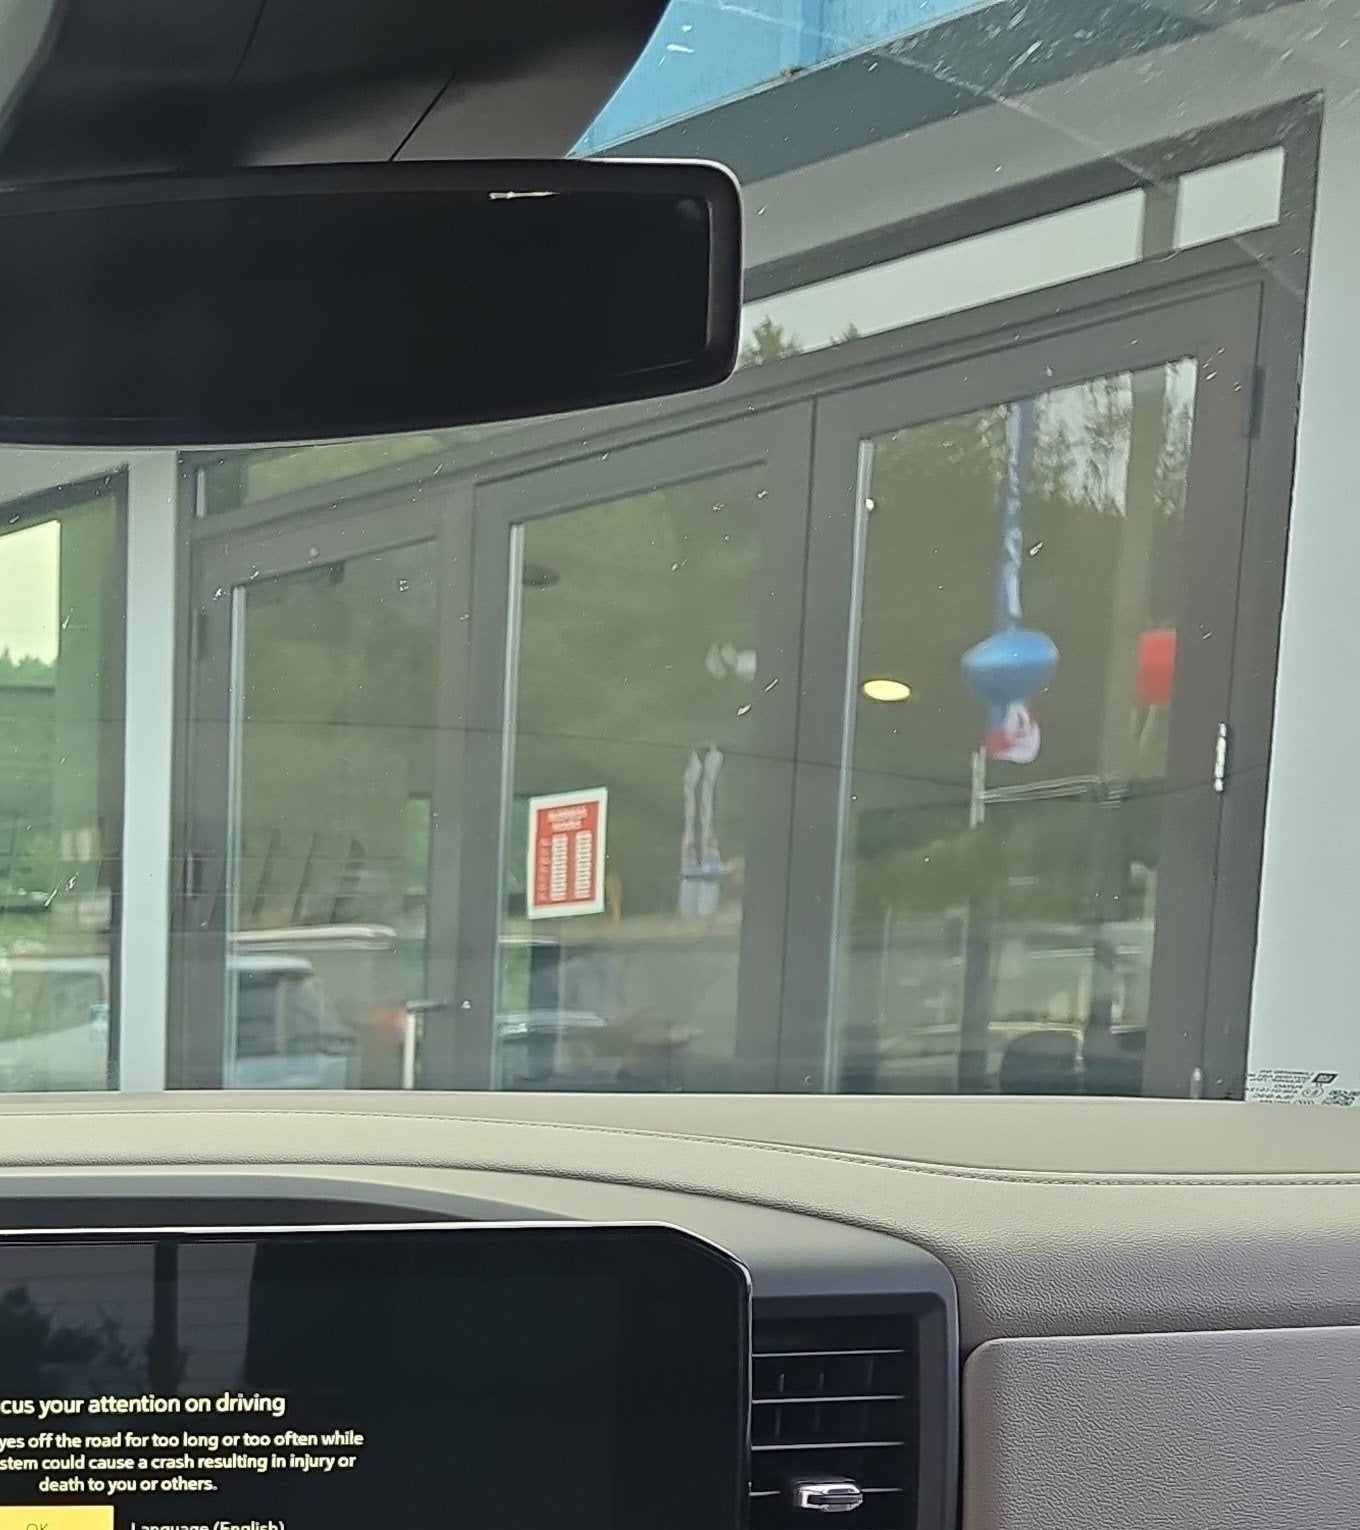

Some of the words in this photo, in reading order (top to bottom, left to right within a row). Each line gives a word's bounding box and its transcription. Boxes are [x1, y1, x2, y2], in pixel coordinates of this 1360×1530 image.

[37, 1399, 85, 1420] your
[87, 1393, 181, 1414] attention
[184, 1397, 212, 1413] on
[215, 1391, 286, 1418] driving
[27, 1432, 54, 1449] off
[54, 1432, 83, 1449] the
[84, 1431, 122, 1448] road
[124, 1431, 150, 1448] for
[150, 1433, 180, 1448] too
[182, 1430, 219, 1452] long
[221, 1435, 241, 1447] or
[242, 1432, 272, 1447] too
[273, 1430, 319, 1447] often
[320, 1429, 364, 1446] while
[41, 1453, 86, 1470] could
[88, 1458, 135, 1470] cause
[137, 1457, 148, 1470] a
[150, 1453, 195, 1470] crash
[197, 1452, 269, 1473] resulting
[271, 1453, 287, 1469] in
[289, 1453, 336, 1473] injury
[337, 1456, 357, 1468] or
[38, 1475, 85, 1492] death
[87, 1477, 105, 1492] to
[106, 1479, 137, 1496] you
[139, 1479, 159, 1492] or
[160, 1475, 218, 1491] others.
